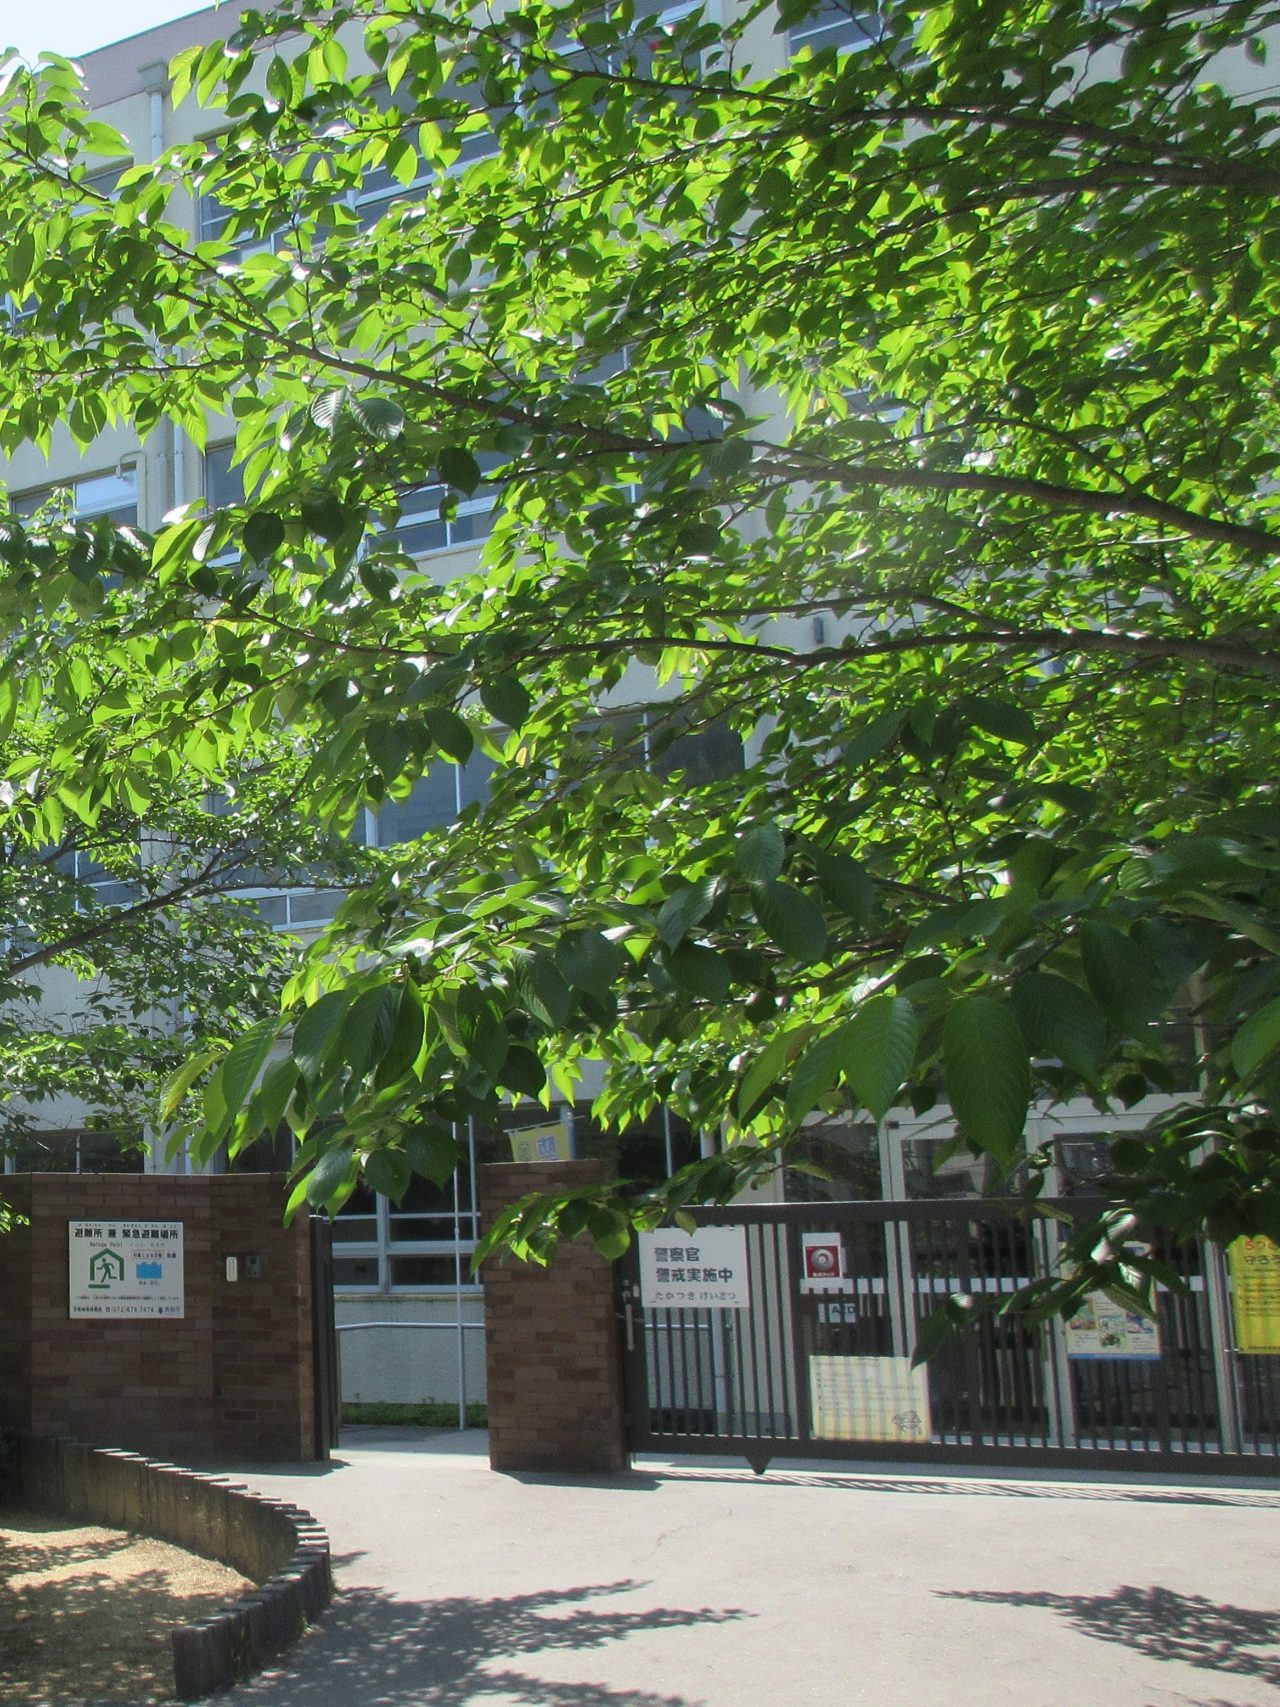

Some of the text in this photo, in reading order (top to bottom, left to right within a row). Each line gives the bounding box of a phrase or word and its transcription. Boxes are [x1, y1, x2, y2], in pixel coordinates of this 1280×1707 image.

[74, 1228, 103, 1238] 避難所
[122, 1228, 179, 1239] 緊急避難場所
[654, 1247, 700, 1262] 警察官
[656, 1267, 733, 1283] 警戒実施中
